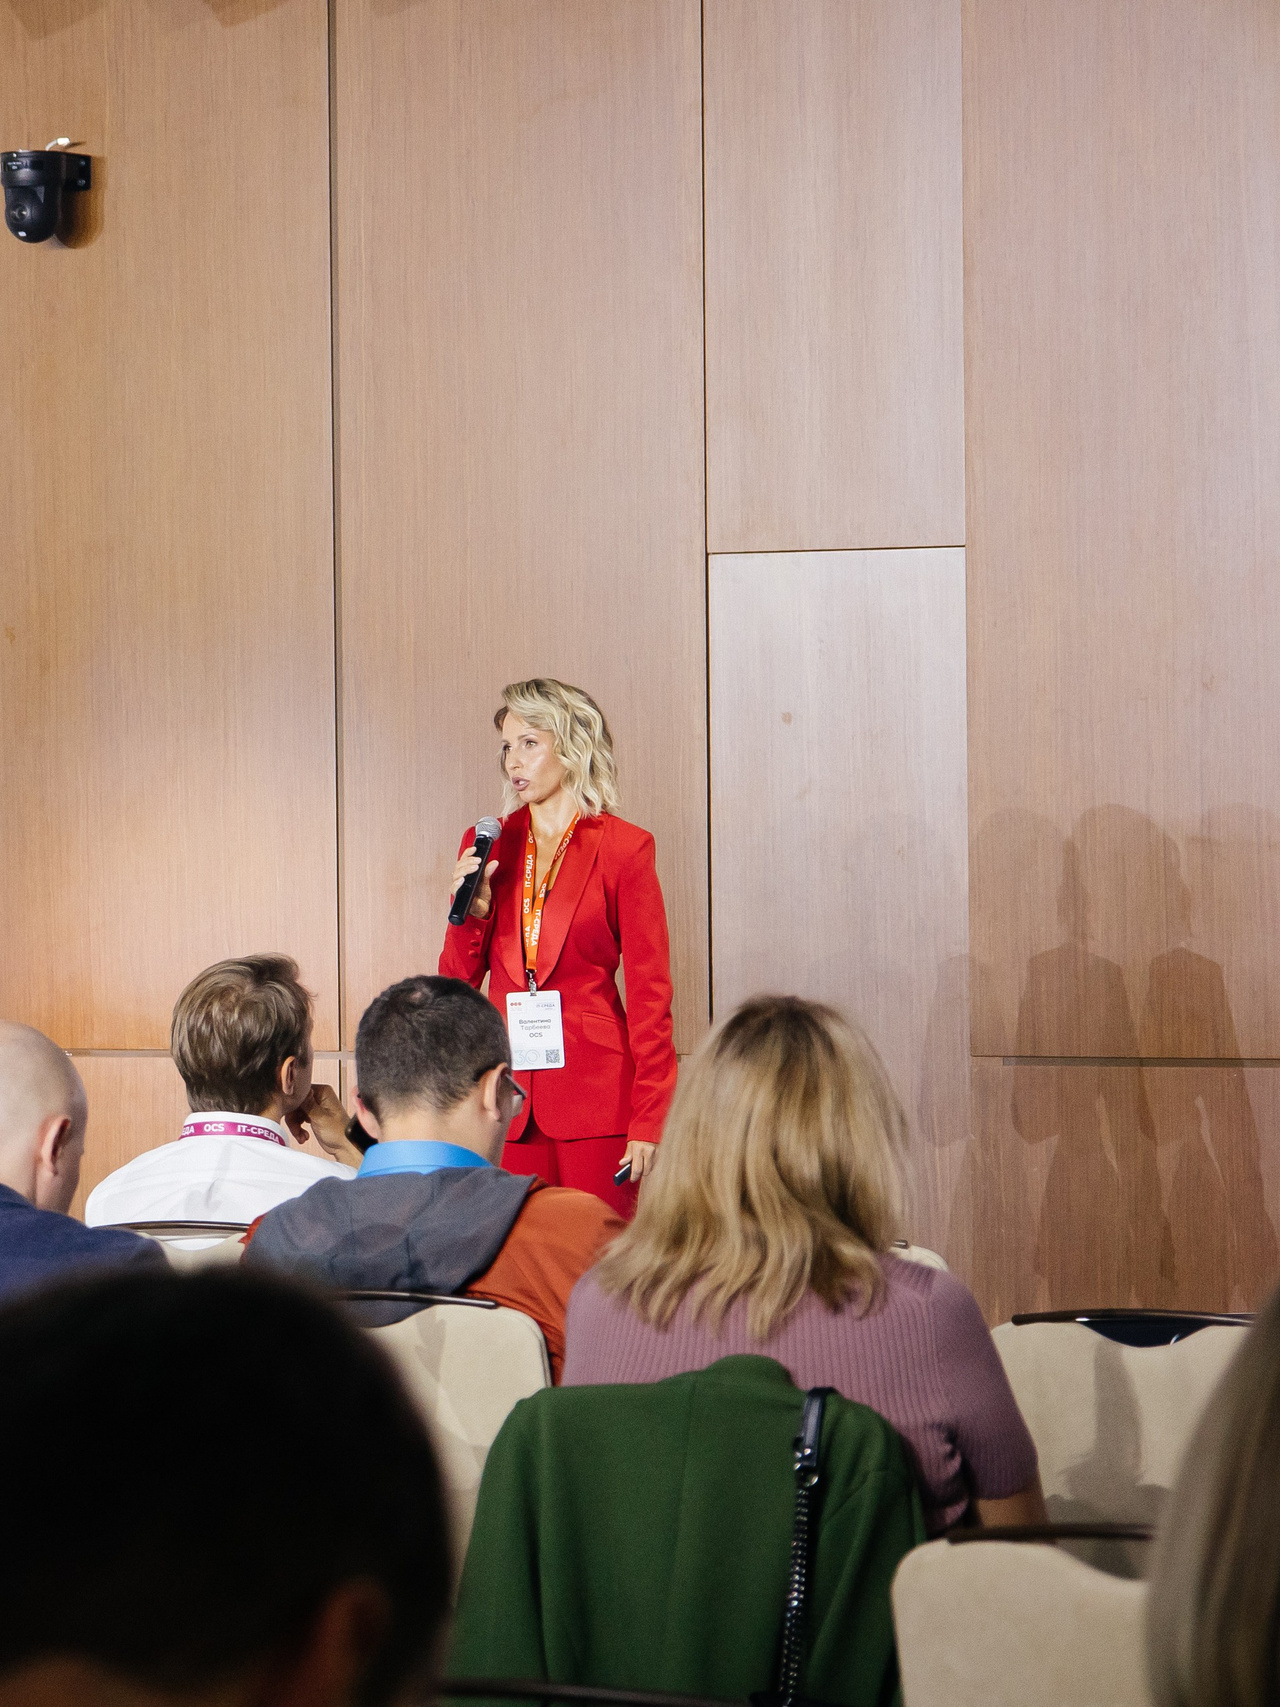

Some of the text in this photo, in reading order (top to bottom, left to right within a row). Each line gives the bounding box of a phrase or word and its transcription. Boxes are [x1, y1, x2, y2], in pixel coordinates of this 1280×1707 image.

[525, 854, 534, 888] IT-СРЕДА
[539, 882, 547, 898] OCS
[523, 897, 531, 914] OCS
[531, 909, 541, 946] IT-СРЕДА
[203, 1123, 225, 1133] OCS
[237, 1124, 279, 1143] IT-СРЕДА
